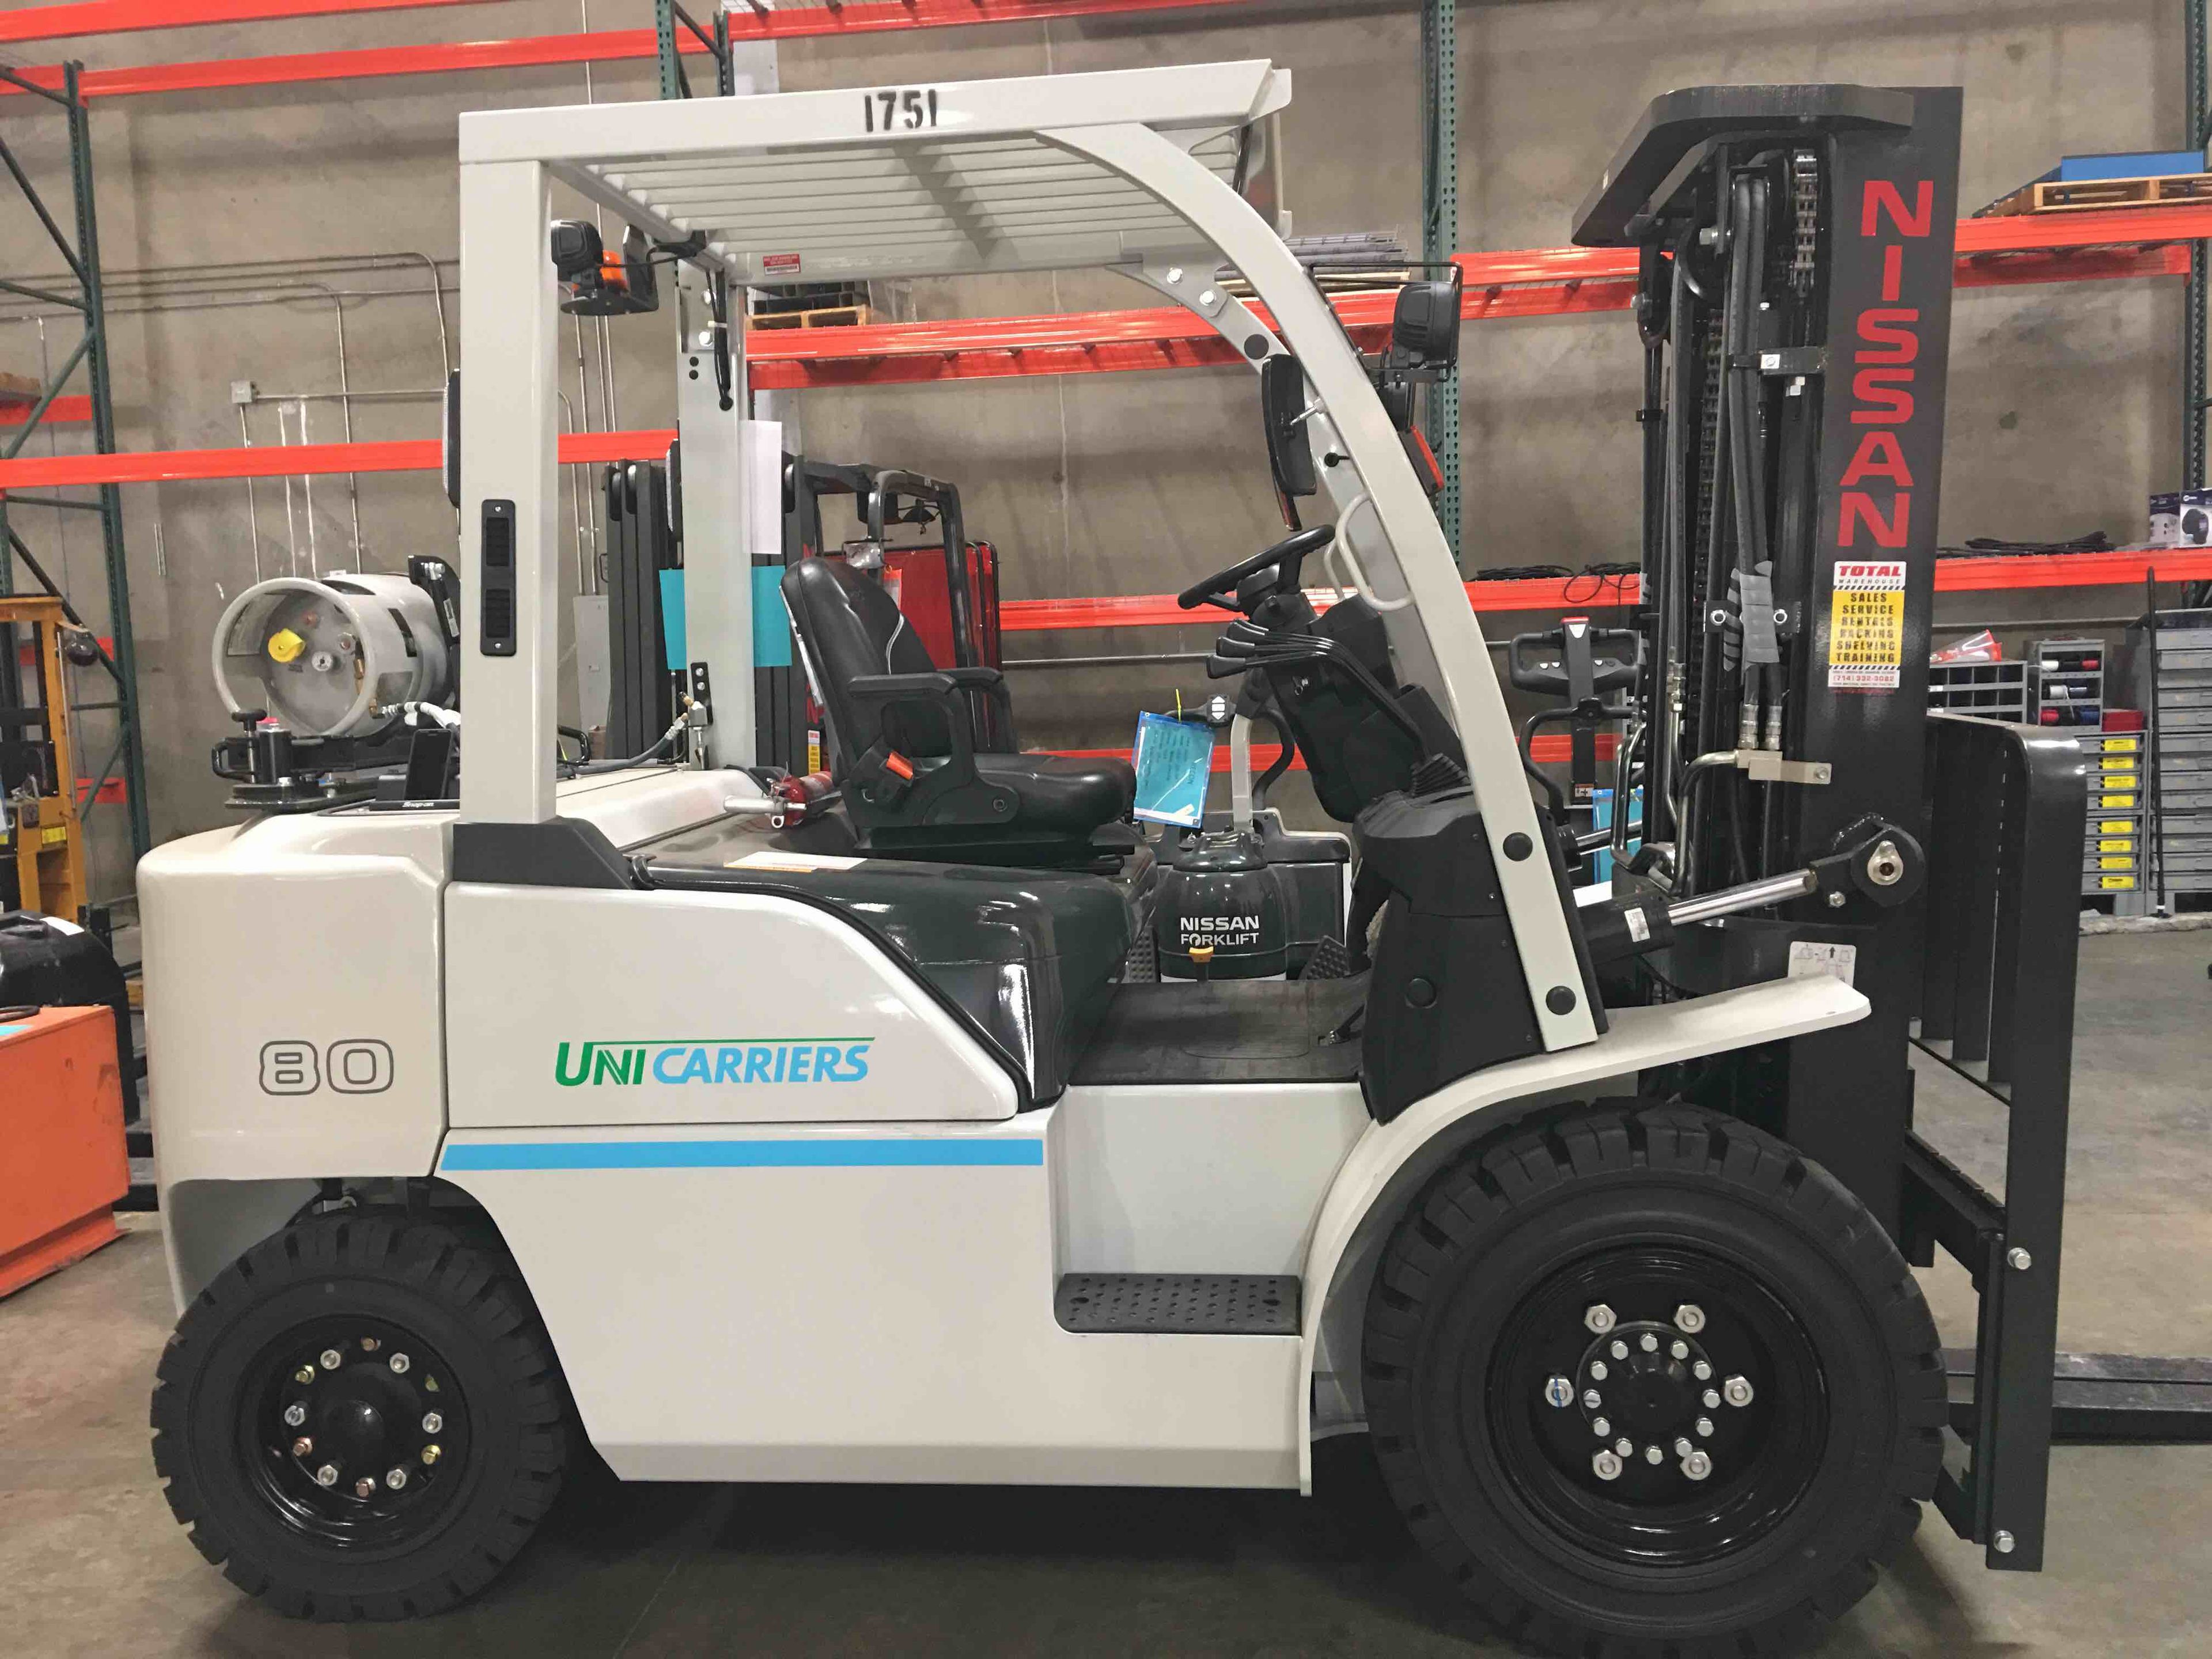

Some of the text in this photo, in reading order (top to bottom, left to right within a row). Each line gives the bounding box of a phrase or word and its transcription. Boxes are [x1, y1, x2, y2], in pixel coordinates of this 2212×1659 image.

[865, 89, 937, 132] 1751
[1838, 180, 1933, 547] NISSAN
[1839, 566, 1901, 576] TOTAL
[1850, 593, 1887, 603] SALES
[1842, 605, 1894, 614] SERVICE
[1836, 640, 1895, 650] SHELVING
[1836, 652, 1895, 662] TRAINING
[1180, 915, 1260, 931] NISSAN
[1180, 933, 1260, 946] FORKLIFT
[259, 1039, 394, 1095] 80
